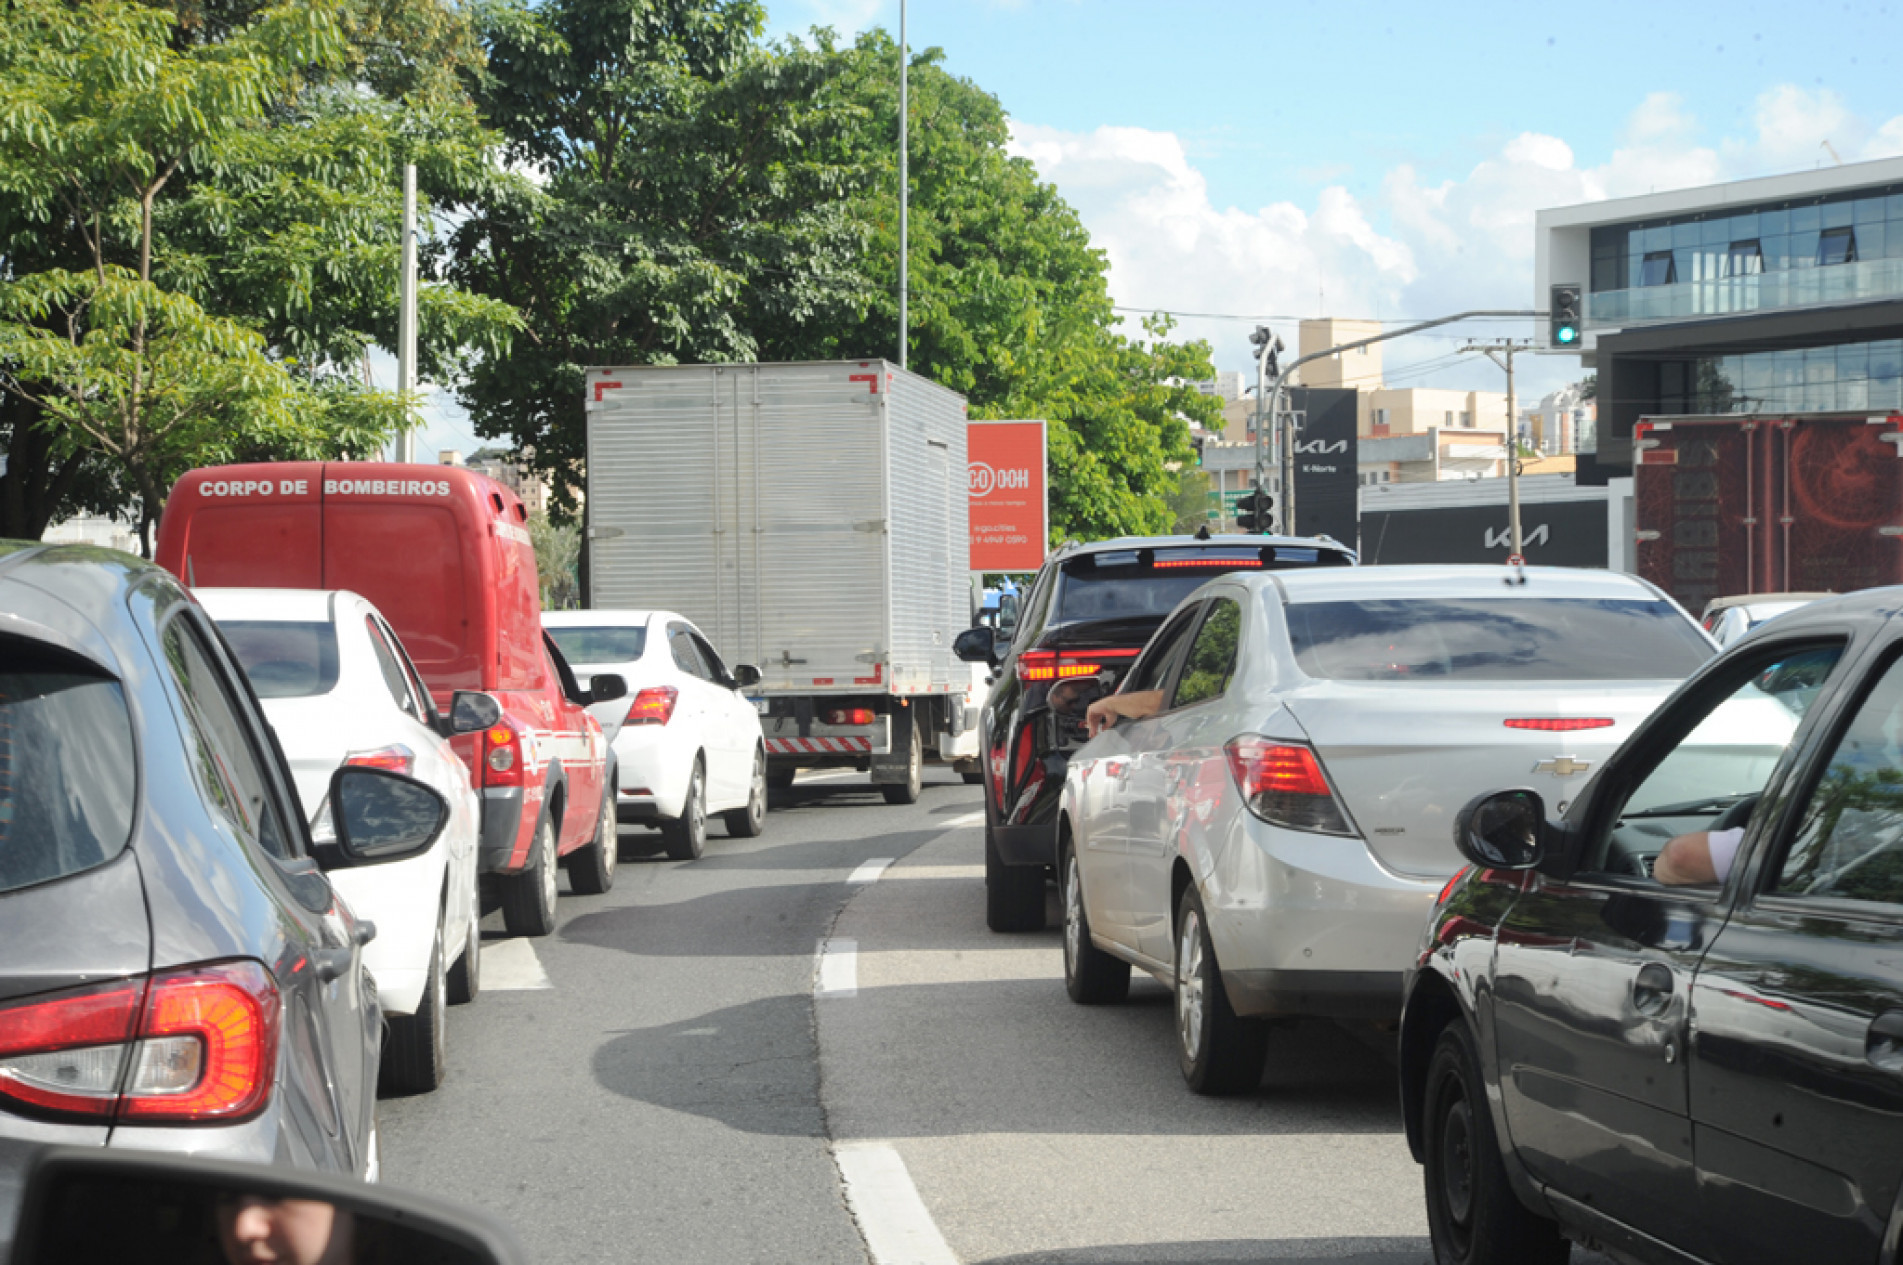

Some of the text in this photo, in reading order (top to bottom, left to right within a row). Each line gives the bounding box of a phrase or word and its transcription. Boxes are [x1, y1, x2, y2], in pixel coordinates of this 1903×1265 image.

[199, 479, 451, 497] CORPO DE BOMBEIROS
[1484, 523, 1549, 549] KA
